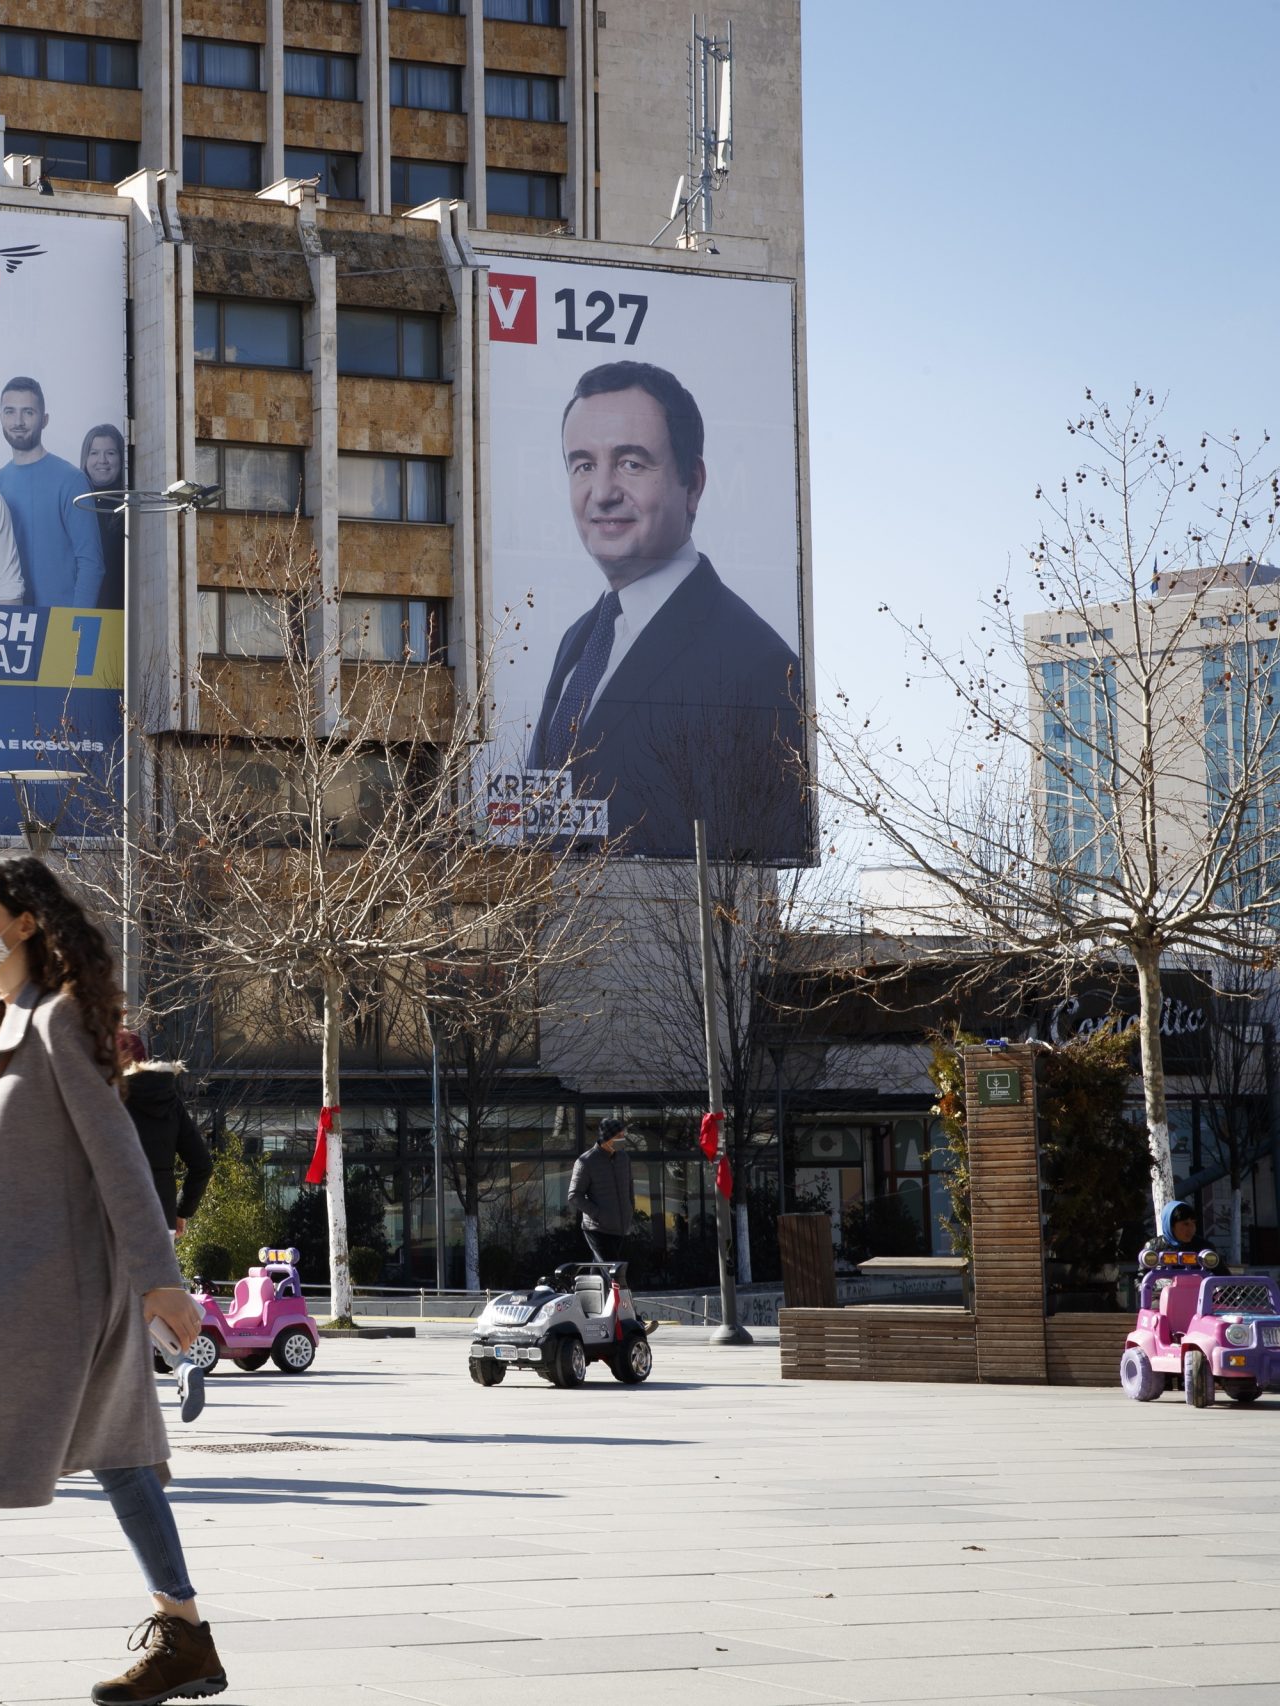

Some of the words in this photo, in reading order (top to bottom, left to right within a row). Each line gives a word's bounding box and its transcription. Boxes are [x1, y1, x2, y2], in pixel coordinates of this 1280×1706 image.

[488, 285, 527, 330] V
[554, 287, 649, 346] 127
[71, 615, 103, 677] 1
[9, 739, 20, 750] E
